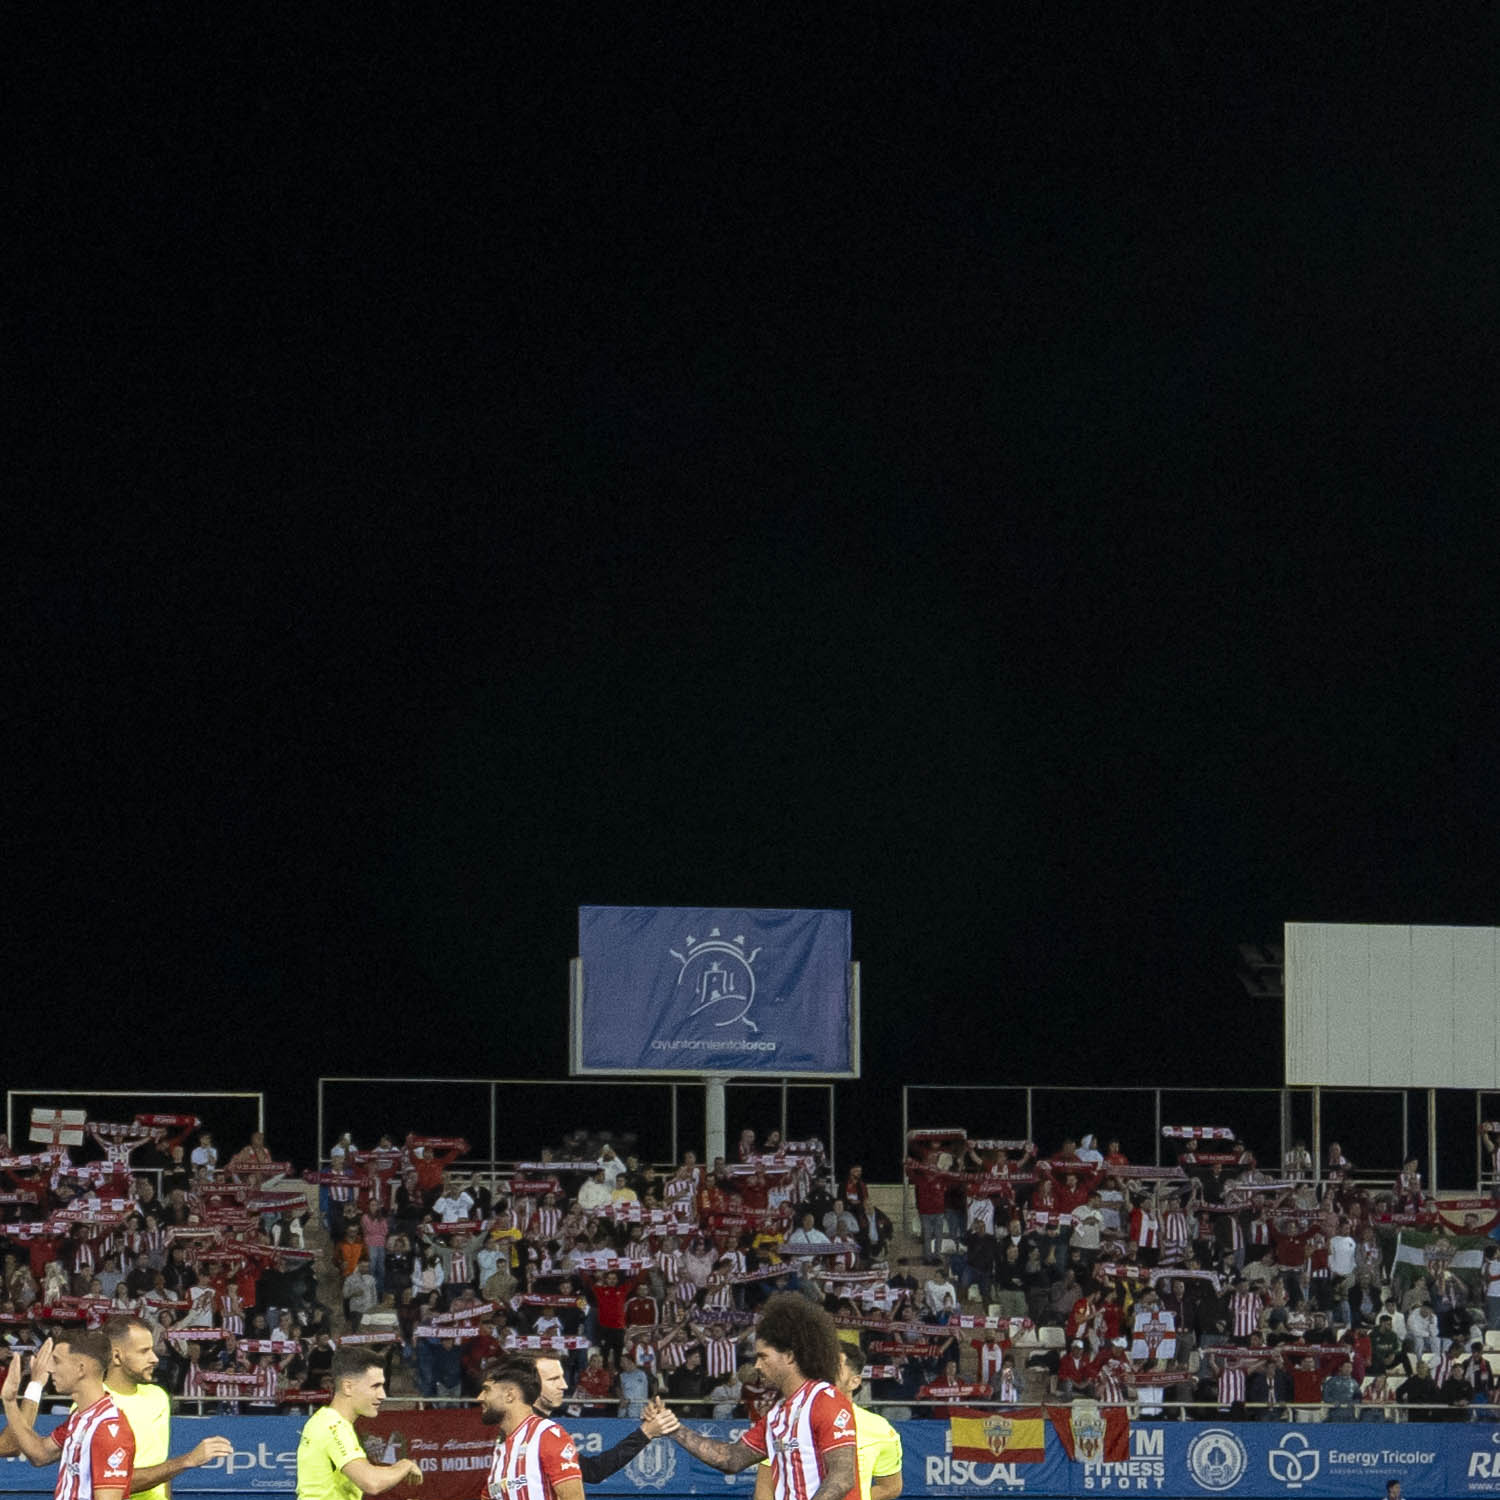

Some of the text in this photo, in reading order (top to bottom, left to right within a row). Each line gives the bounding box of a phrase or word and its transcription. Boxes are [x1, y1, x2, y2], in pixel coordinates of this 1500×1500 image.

[441, 1454, 493, 1472] MOLINO
[1328, 1449, 1436, 1467] Energy Tricolor
[926, 1455, 1025, 1486] RISCAL
[1084, 1462, 1165, 1477] FITNESS
[1084, 1477, 1165, 1489] SPORT
